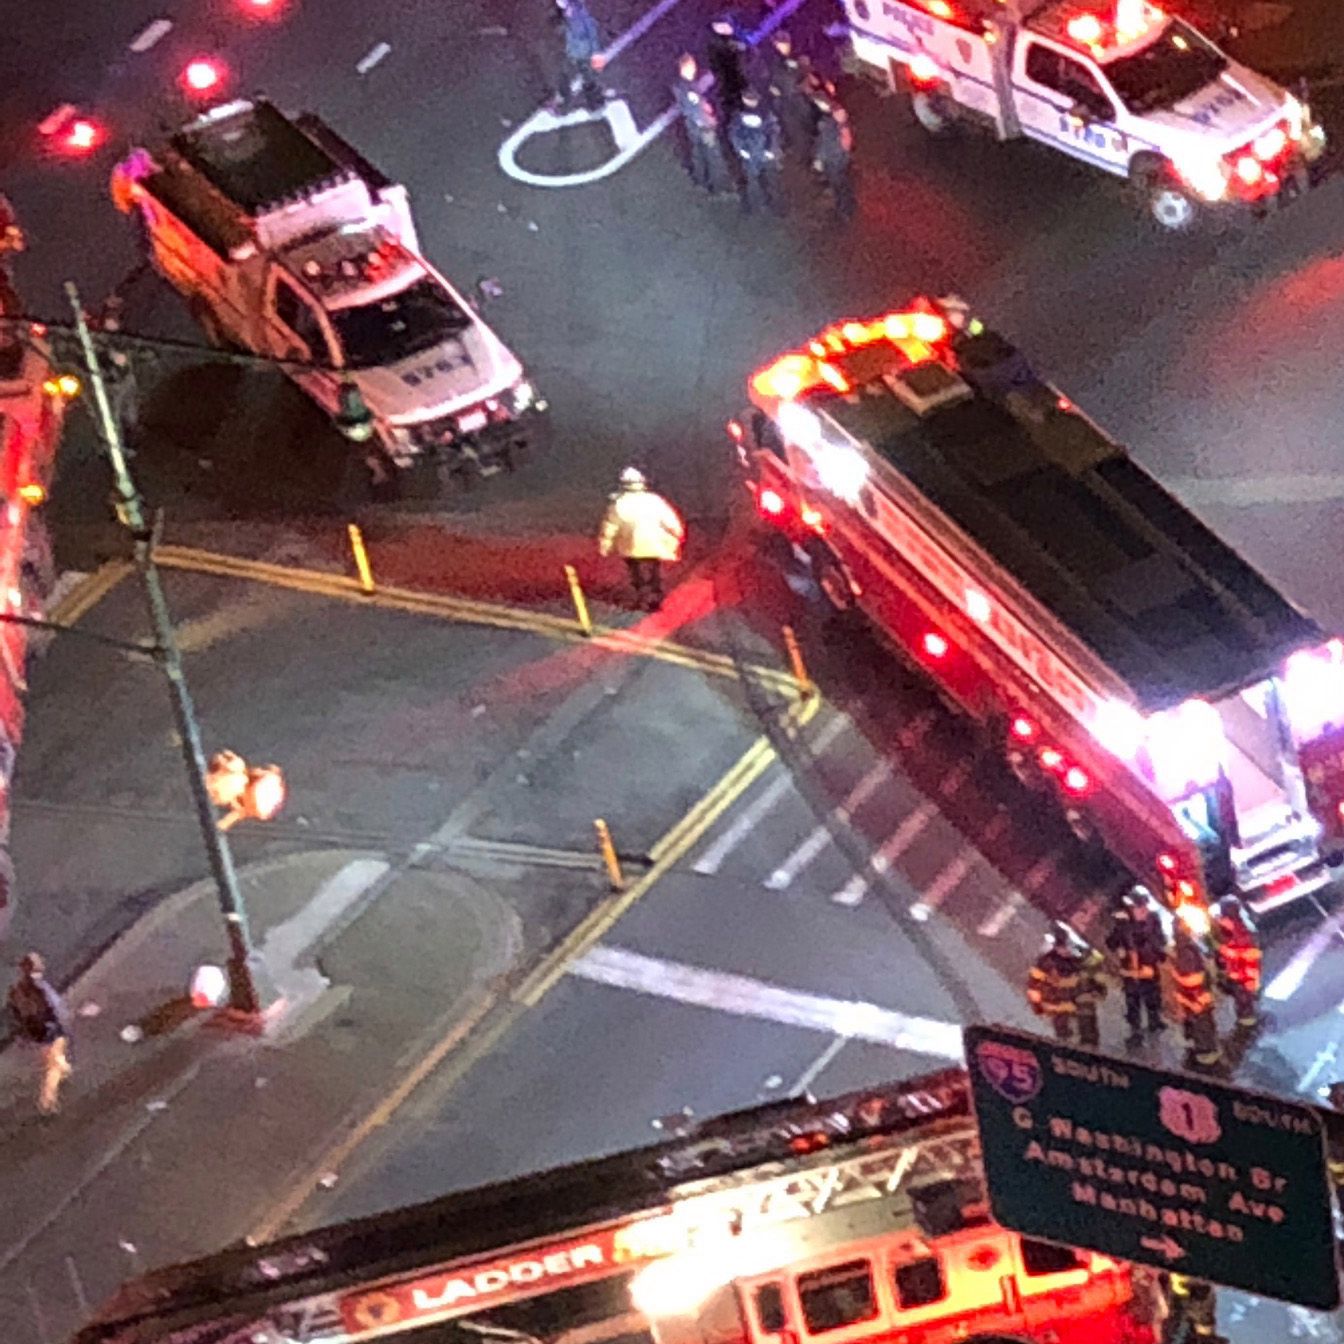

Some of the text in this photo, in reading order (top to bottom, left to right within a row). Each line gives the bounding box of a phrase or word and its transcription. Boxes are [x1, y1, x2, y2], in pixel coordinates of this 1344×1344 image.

[1012, 1106, 1034, 1130] G
[1049, 1116, 1239, 1182] Washington
[1181, 1102, 1195, 1132] 1
[1023, 1139, 1286, 1224] Amsterdam Ave
[1070, 1181, 1245, 1243] Manhattan
[412, 1244, 604, 1310] LADDER
